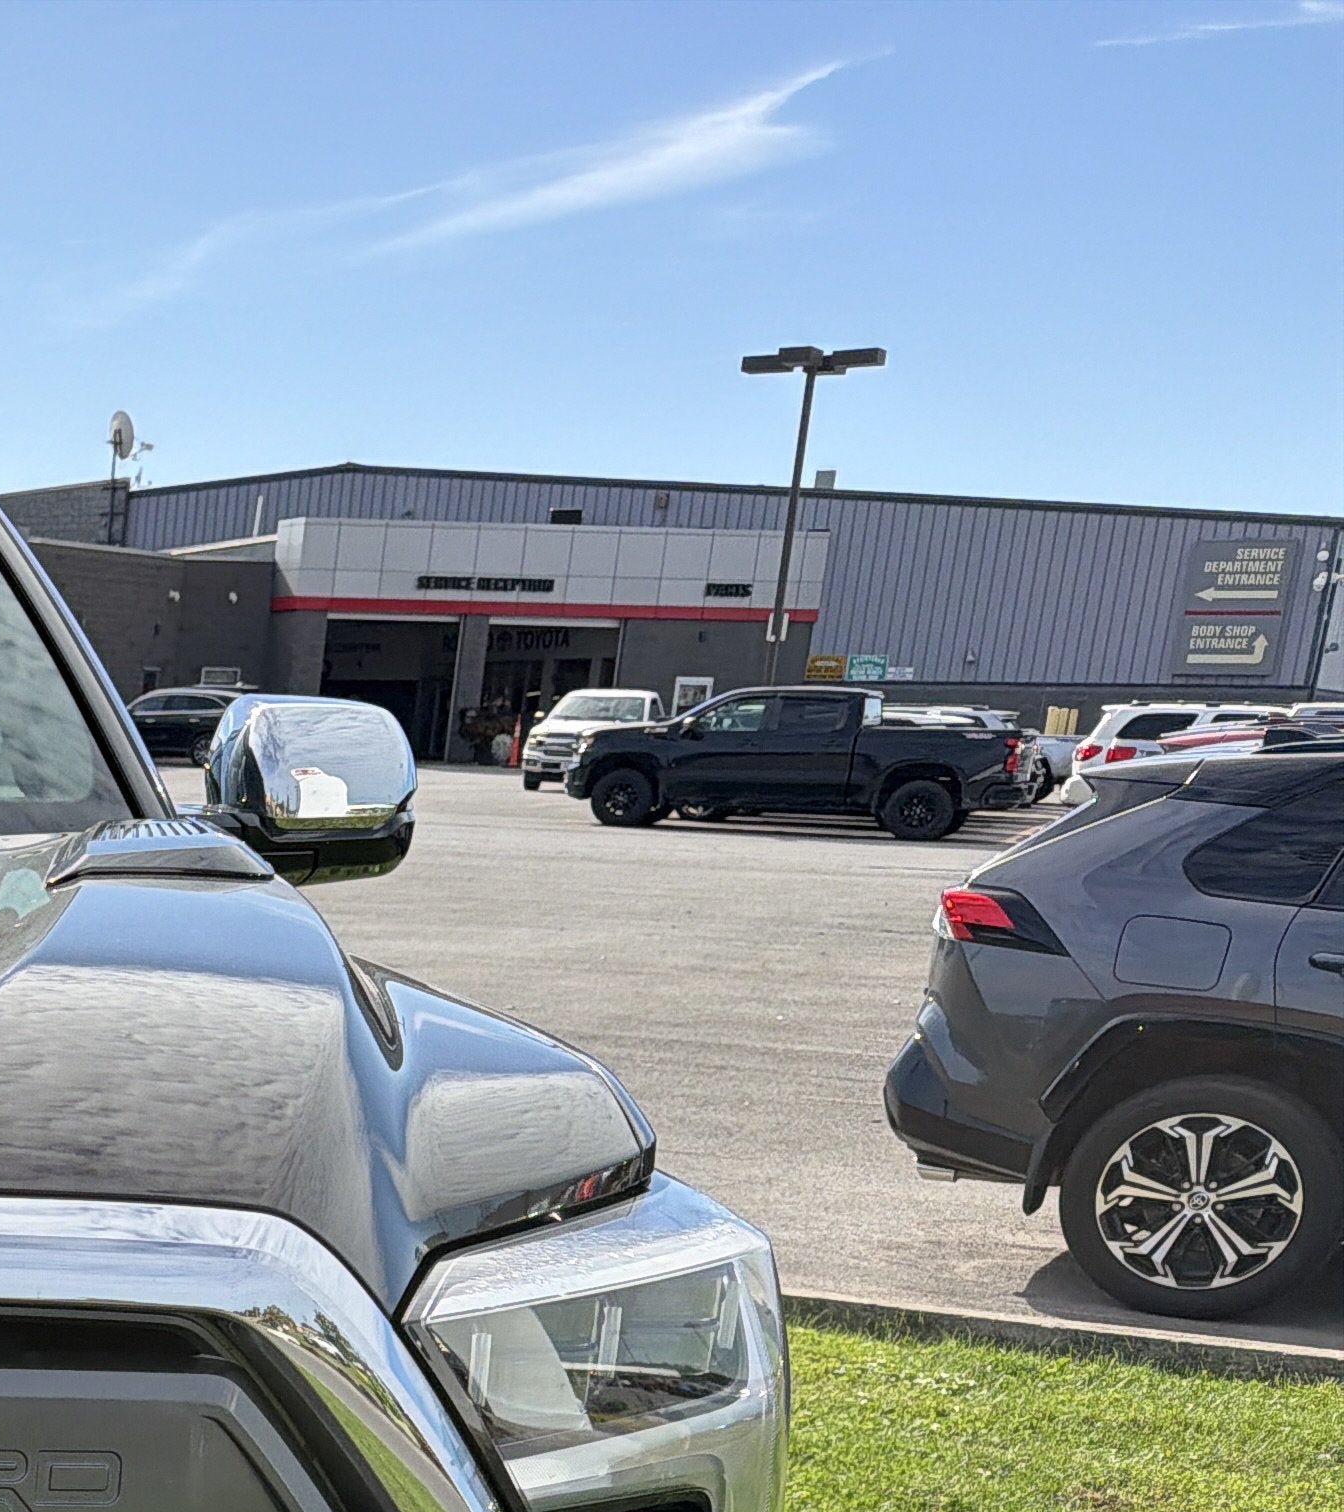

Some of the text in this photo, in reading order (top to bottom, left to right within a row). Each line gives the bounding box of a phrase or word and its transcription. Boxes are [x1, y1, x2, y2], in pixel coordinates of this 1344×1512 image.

[1236, 547, 1287, 560] SERVICE
[1204, 560, 1285, 573] DEPARTMENT
[417, 576, 475, 591] SERVICE
[1217, 573, 1281, 585] ENTRANCE
[1191, 625, 1256, 637] BODY SHOP
[516, 628, 570, 650] TOYOTA
[1189, 638, 1249, 650] ENTRANCE
